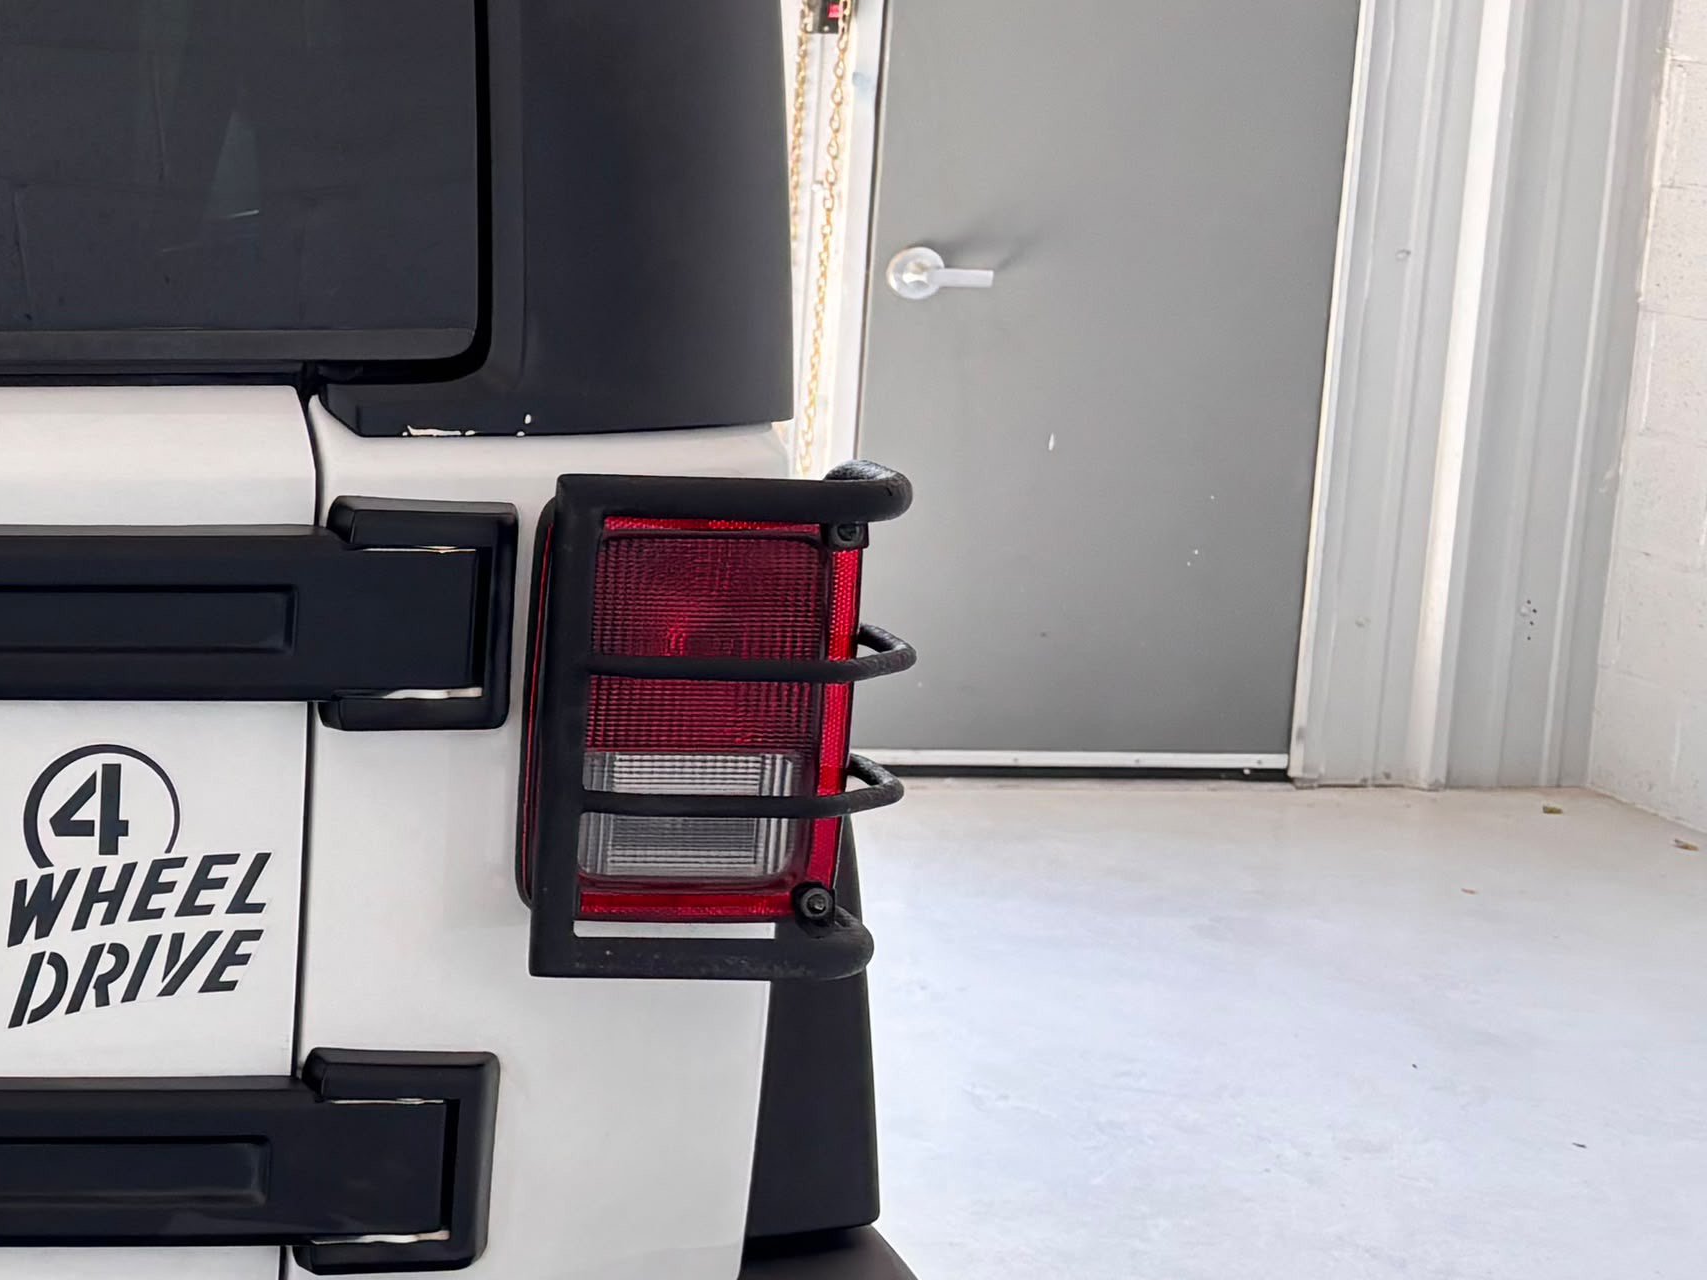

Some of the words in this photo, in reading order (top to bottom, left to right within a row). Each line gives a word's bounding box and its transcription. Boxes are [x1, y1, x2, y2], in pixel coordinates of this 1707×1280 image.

[49, 763, 129, 855] 4
[7, 852, 272, 947] WHEEL
[7, 929, 264, 1029] DRIVE
